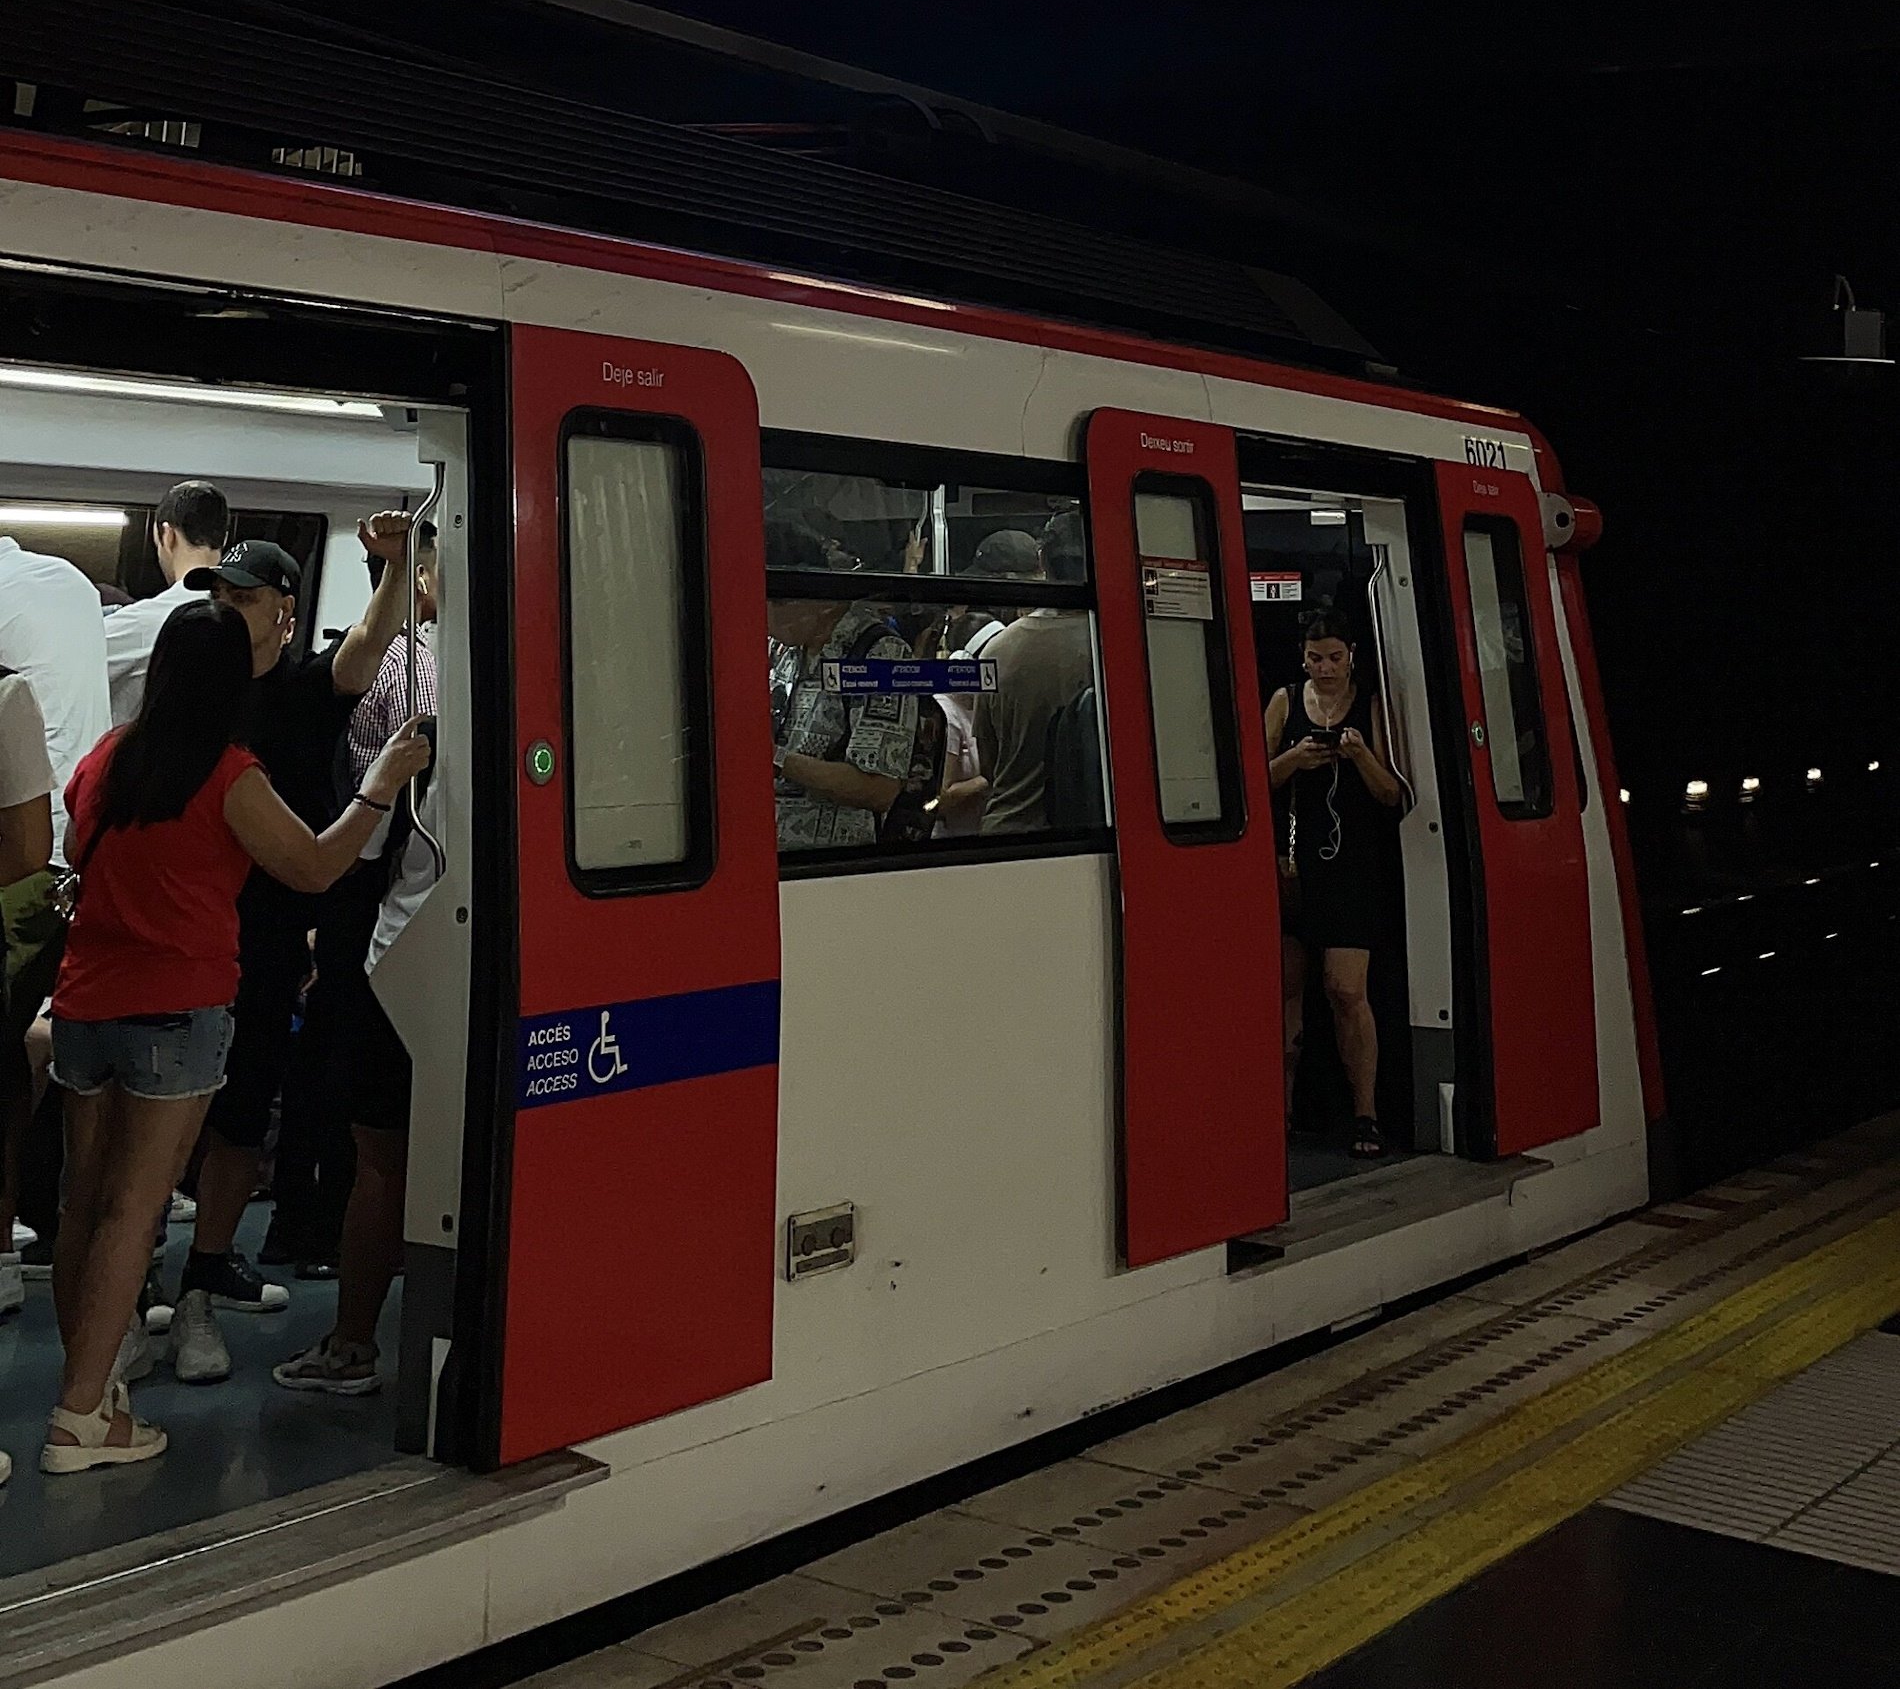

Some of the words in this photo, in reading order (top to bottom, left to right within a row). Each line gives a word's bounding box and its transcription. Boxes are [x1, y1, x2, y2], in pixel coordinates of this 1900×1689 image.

[602, 361, 634, 388] Deje
[636, 367, 665, 388] salir
[1464, 438, 1507, 471] 6021
[527, 1022, 571, 1047] ACCÉS
[526, 1048, 579, 1071] ACCESO
[525, 1072, 579, 1097] ACCESS
